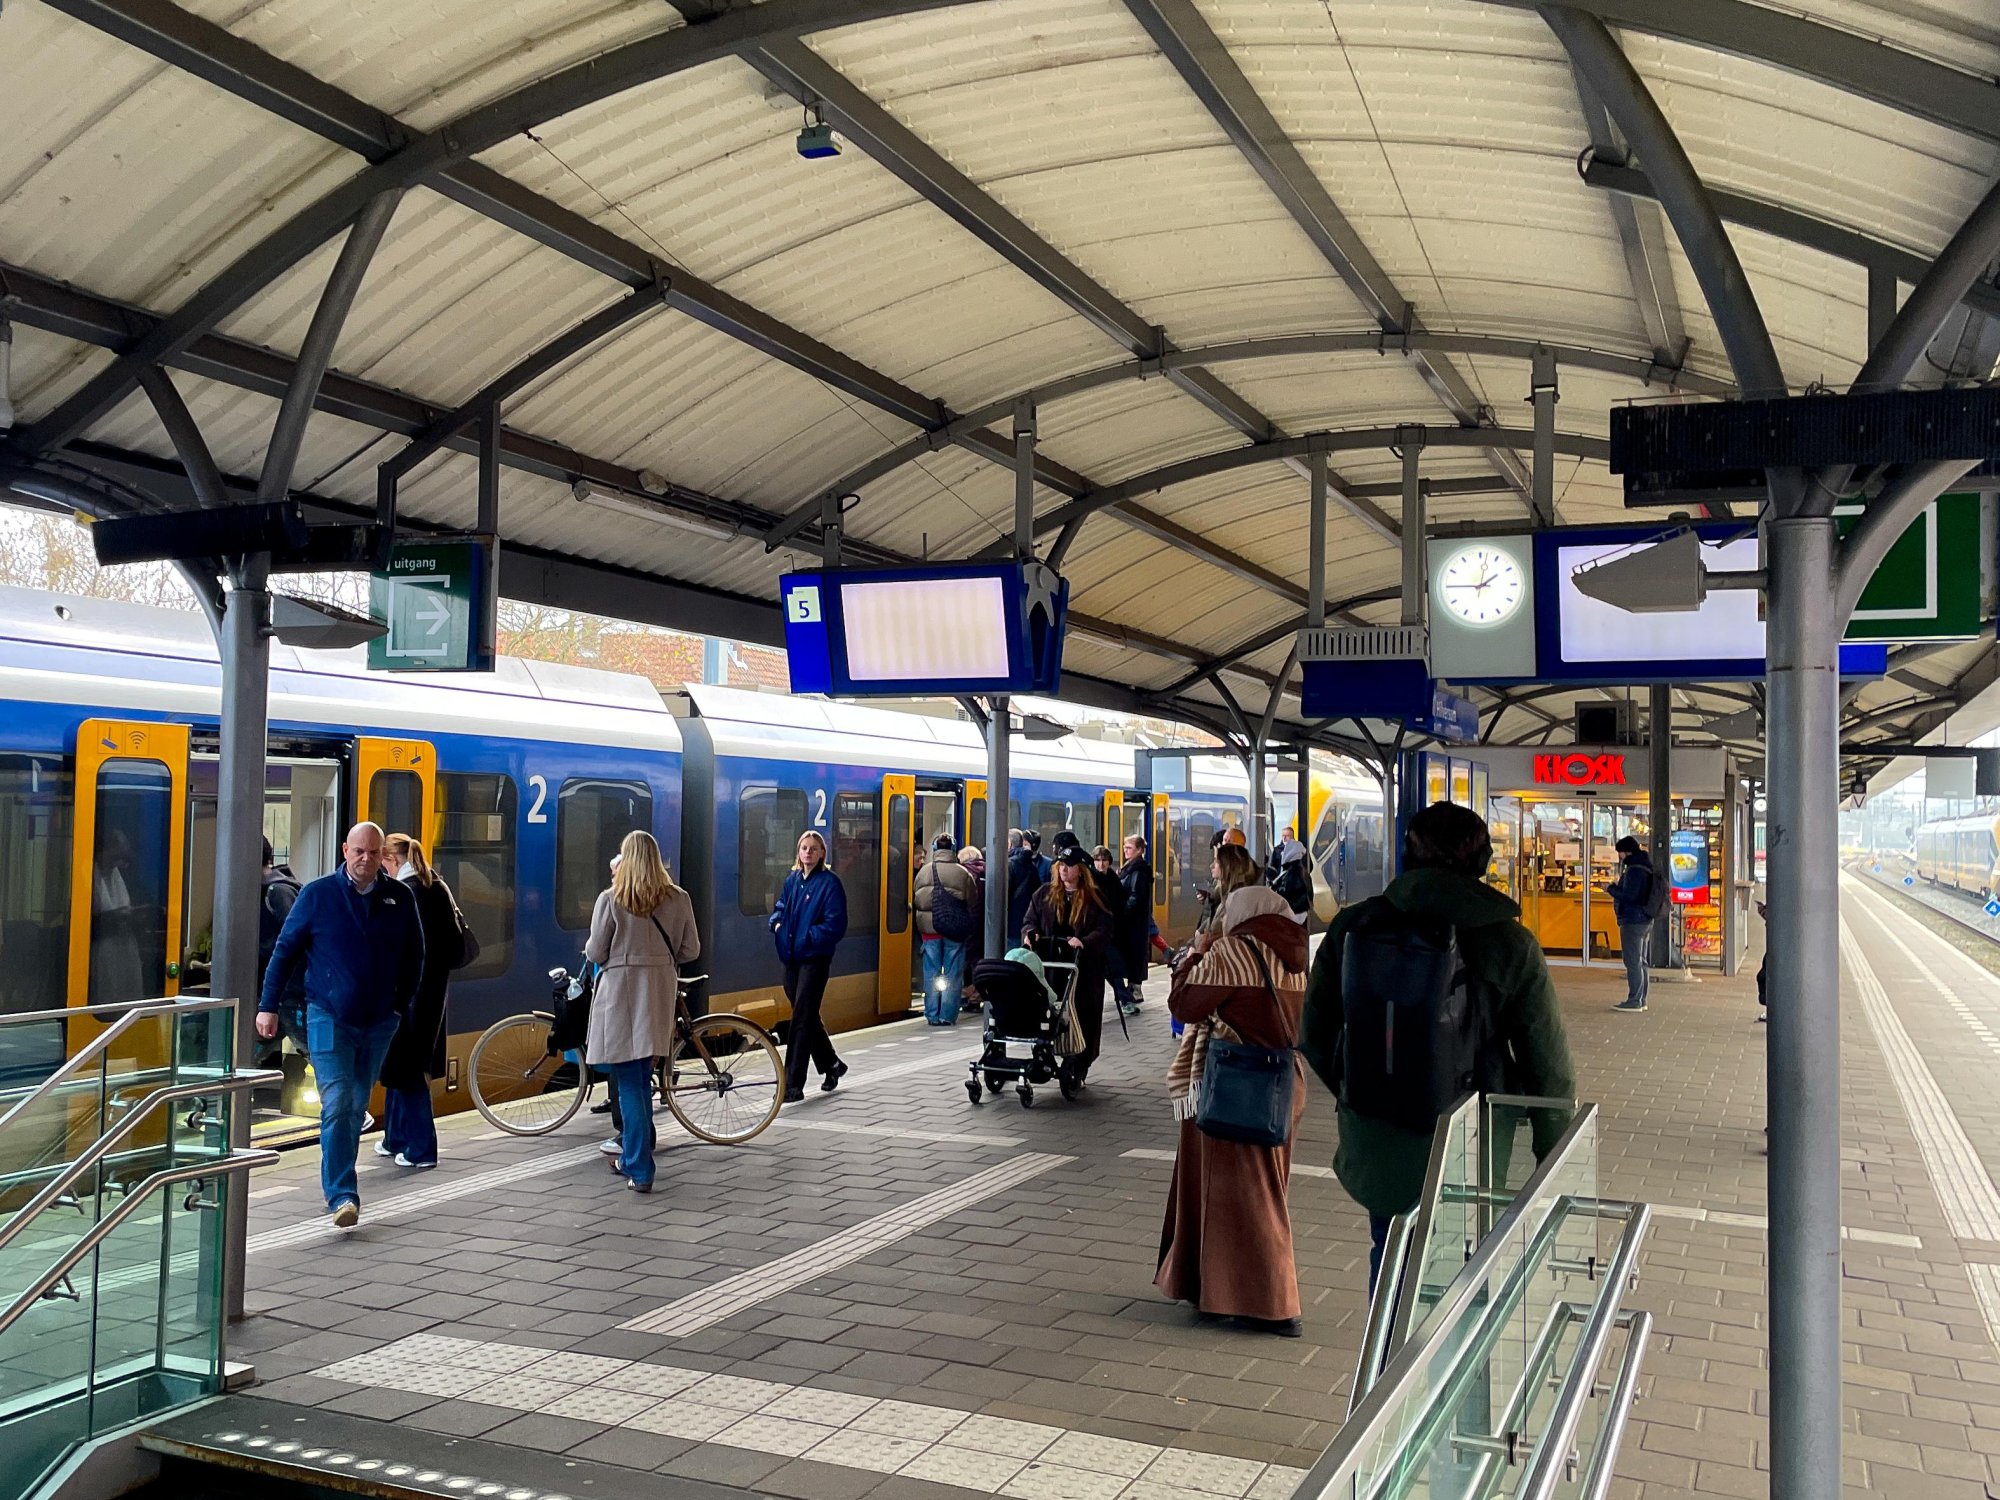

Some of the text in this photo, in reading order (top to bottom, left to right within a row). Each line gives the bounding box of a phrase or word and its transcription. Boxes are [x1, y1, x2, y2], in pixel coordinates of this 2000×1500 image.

[394, 558, 436, 571] uitgang
[798, 600, 810, 618] 5
[1533, 753, 1626, 786] KIOSK
[527, 775, 547, 823] 2
[814, 789, 826, 827] 2
[1065, 801, 1073, 830] 2
